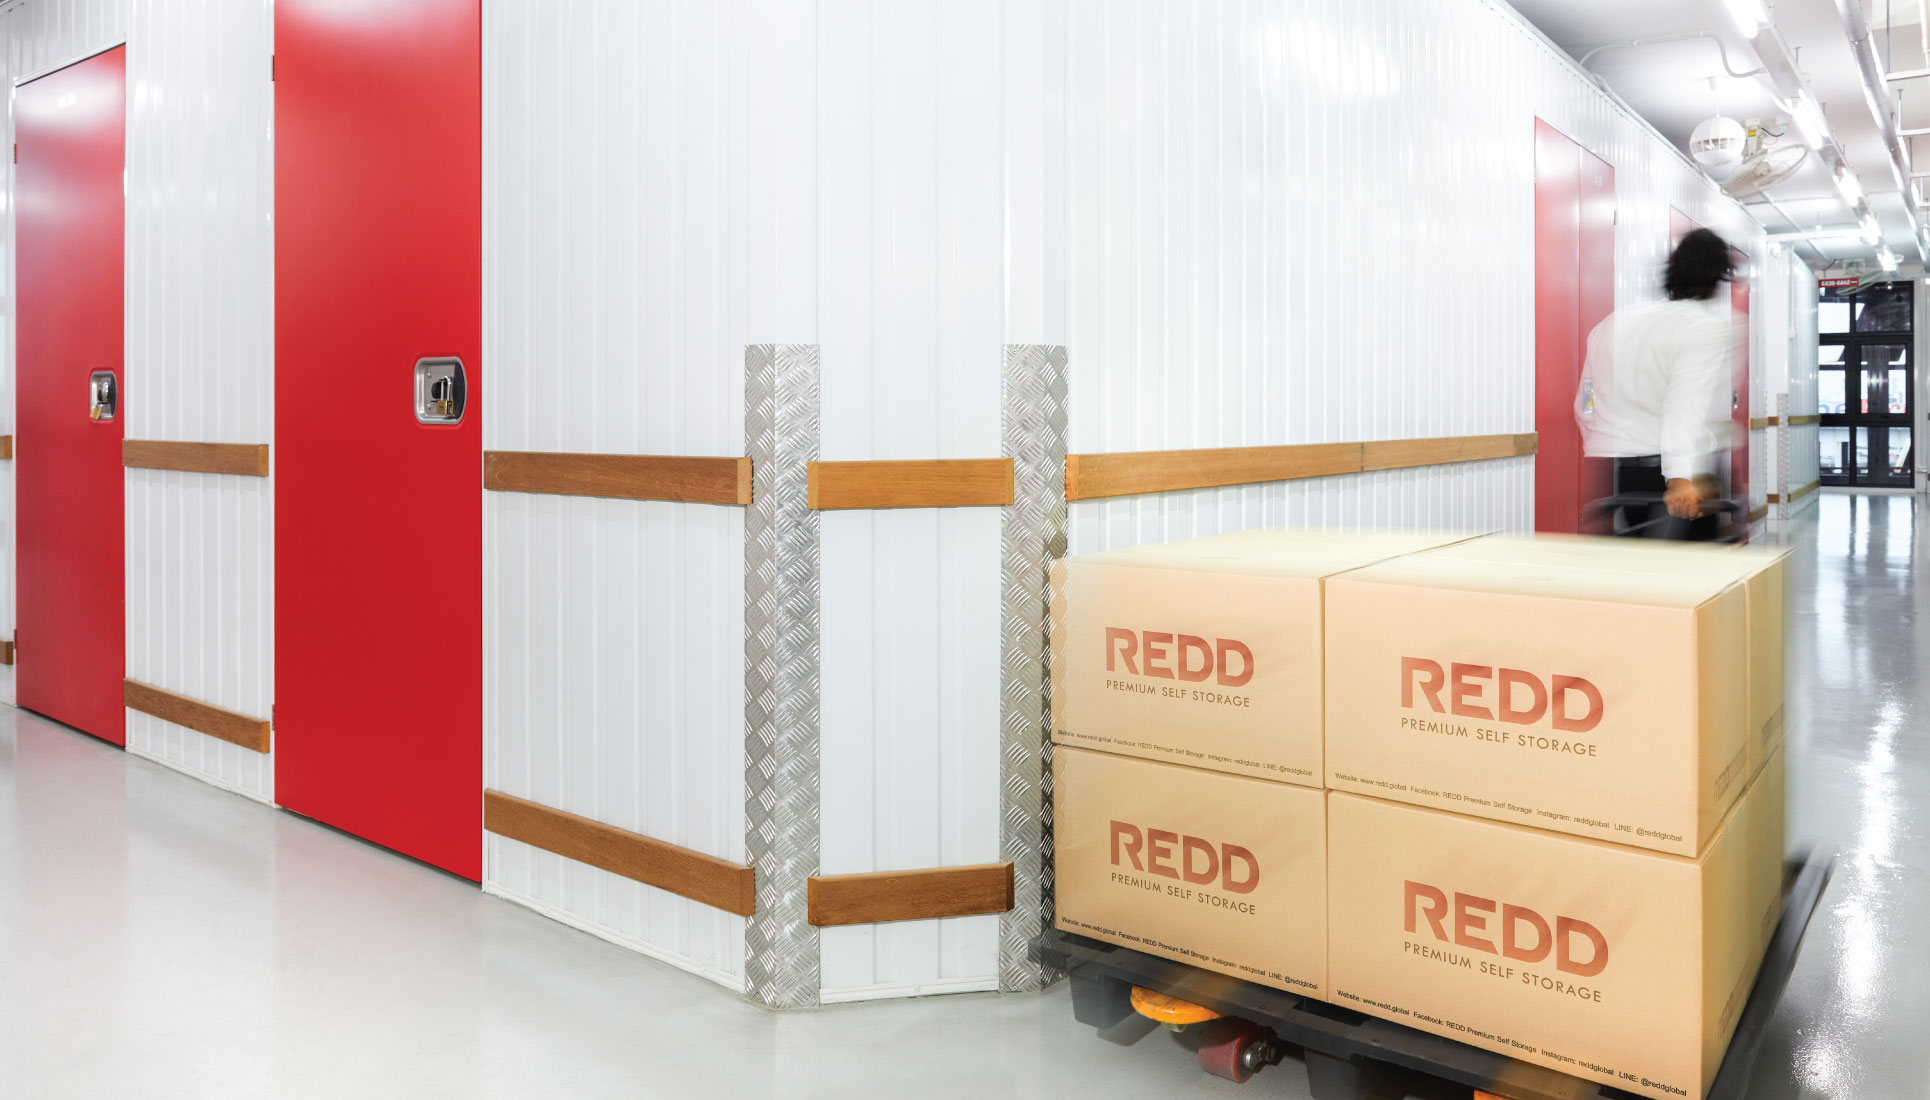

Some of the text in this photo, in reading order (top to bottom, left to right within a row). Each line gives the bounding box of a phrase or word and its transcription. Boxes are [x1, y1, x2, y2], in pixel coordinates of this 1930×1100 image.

[1106, 627, 1254, 687] REDD
[1107, 680, 1250, 707] PREMIUM SELF STORAGE
[1401, 656, 1604, 733] REDD
[1401, 718, 1597, 757] PREMIUM SELF STORAGE
[1410, 786, 1440, 796] Facebook:
[1443, 791, 1462, 800] REDD
[1463, 796, 1491, 806] Premium
[1493, 800, 1506, 809] Self
[1507, 803, 1532, 814] Storage
[1537, 809, 1572, 821] Instagram:
[1574, 816, 1609, 829] reddglobal
[1614, 823, 1633, 833] LINE:
[1636, 827, 1682, 842] @reddglobal
[1110, 820, 1260, 895] REDD
[1111, 872, 1256, 915] PREMIUM SELF STORAGE
[1404, 879, 1609, 977] REDD
[1142, 938, 1157, 947] REDD
[1158, 942, 1178, 952] Premium
[1180, 948, 1190, 956] Self
[1190, 950, 1209, 961] Storage
[1285, 976, 1318, 989] @reddglobal
[1404, 941, 1601, 1003] PREMIUM SELF STORAGE
[1337, 989, 1687, 1097] Website: www.redd.global Facebook: REDD Premium Self Storage Instagram: reddglobal LINE: @reddglobal
